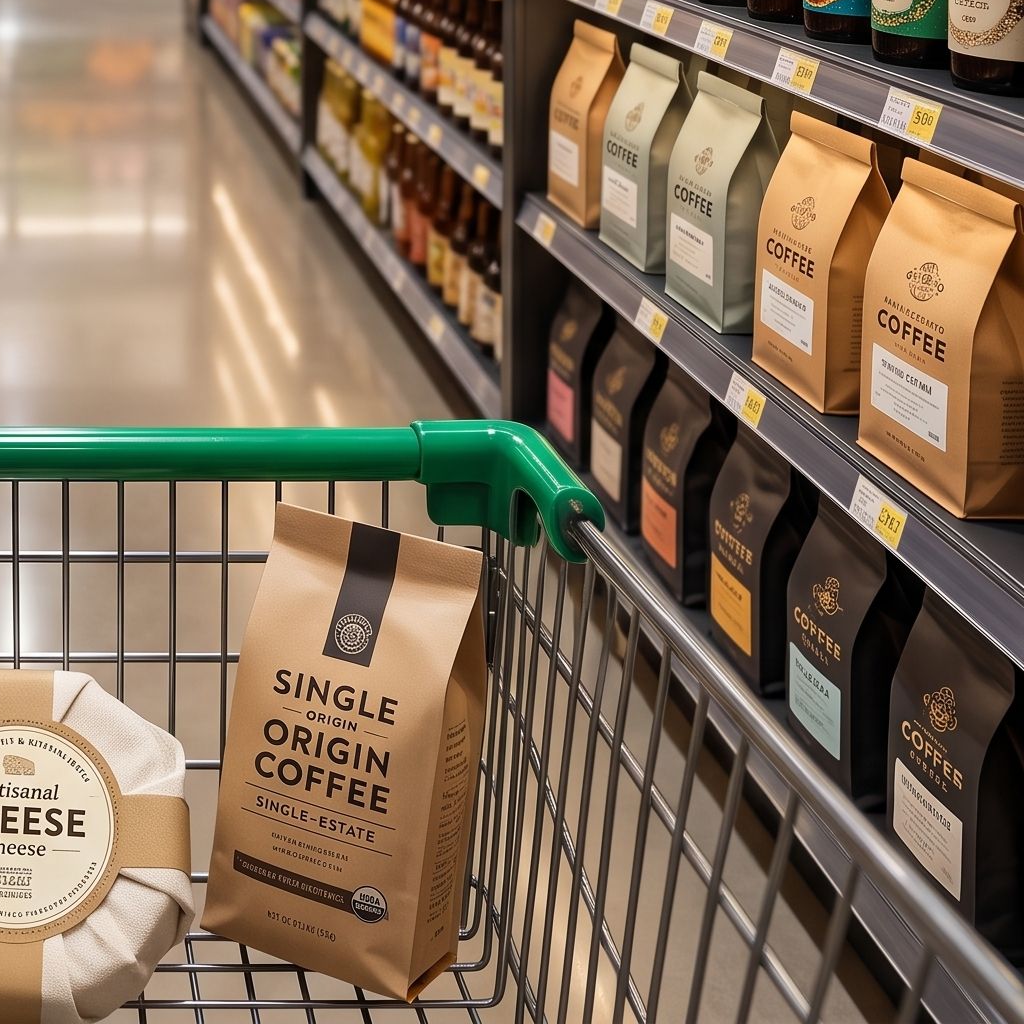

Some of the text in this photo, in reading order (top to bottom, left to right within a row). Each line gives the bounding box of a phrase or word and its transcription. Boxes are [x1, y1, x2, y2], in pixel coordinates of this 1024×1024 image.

[674, 184, 713, 218] COFFEE
[765, 237, 815, 279] COFFEE
[877, 308, 947, 363] COFFEE
[794, 606, 841, 661] COFFEE
[273, 668, 398, 726] SINGLE
[306, 710, 358, 732] ORIGIN
[263, 719, 390, 778] ORIGIN
[254, 751, 389, 816] COFFEE
[256, 795, 375, 843] SINGLE-ESTATE
